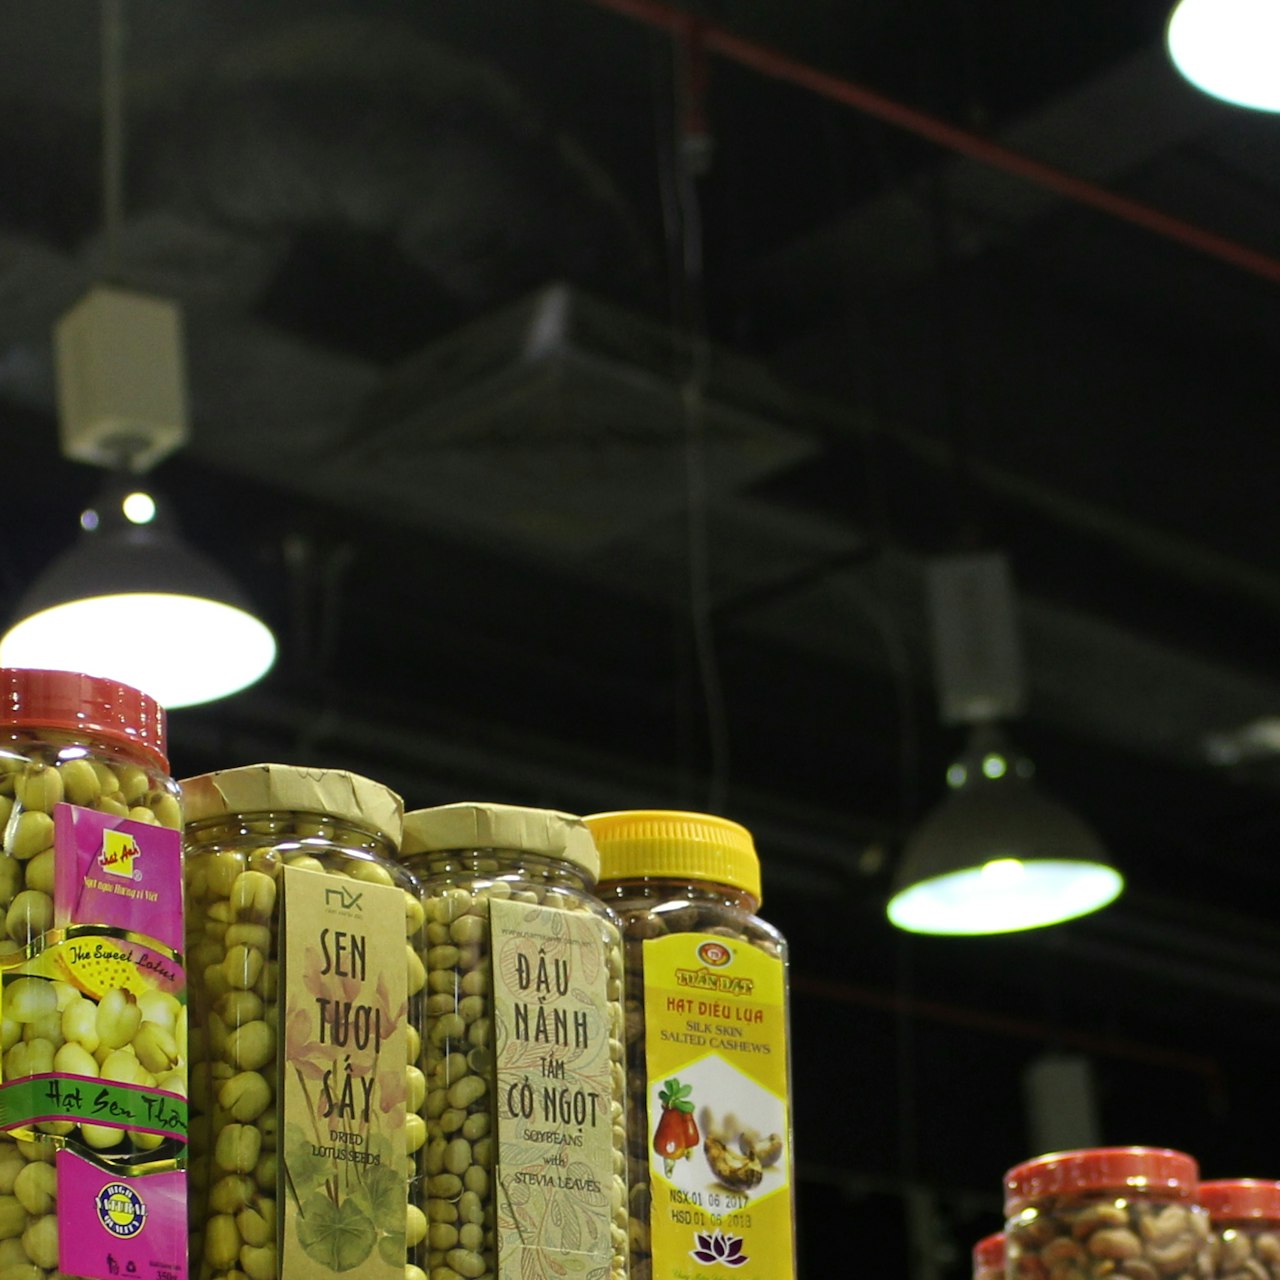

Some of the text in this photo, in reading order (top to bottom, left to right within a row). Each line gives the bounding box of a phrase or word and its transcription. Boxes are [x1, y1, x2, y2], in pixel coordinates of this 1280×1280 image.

[70, 945, 175, 981] The Sweet Lotus
[320, 927, 366, 982] SEN
[667, 997, 694, 1016] HẠT
[736, 1008, 763, 1026] LỤA
[317, 998, 382, 1054] TƯƠI
[686, 1021, 742, 1036] SILK SKIN
[661, 1030, 771, 1054] SALTED CASHEWS
[46, 1079, 82, 1112] Hạt
[92, 1089, 135, 1118] Sen
[323, 1055, 376, 1124] SẤY
[507, 1080, 599, 1132] CỎ NGỌT
[330, 1129, 364, 1147] DRIED
[523, 1128, 583, 1149] SOYBEANS
[312, 1145, 381, 1167] LOTUS SEEDS
[543, 1153, 565, 1167] with
[515, 1172, 600, 1193] STEVIA LEAVES
[726, 1194, 748, 1208] 2017
